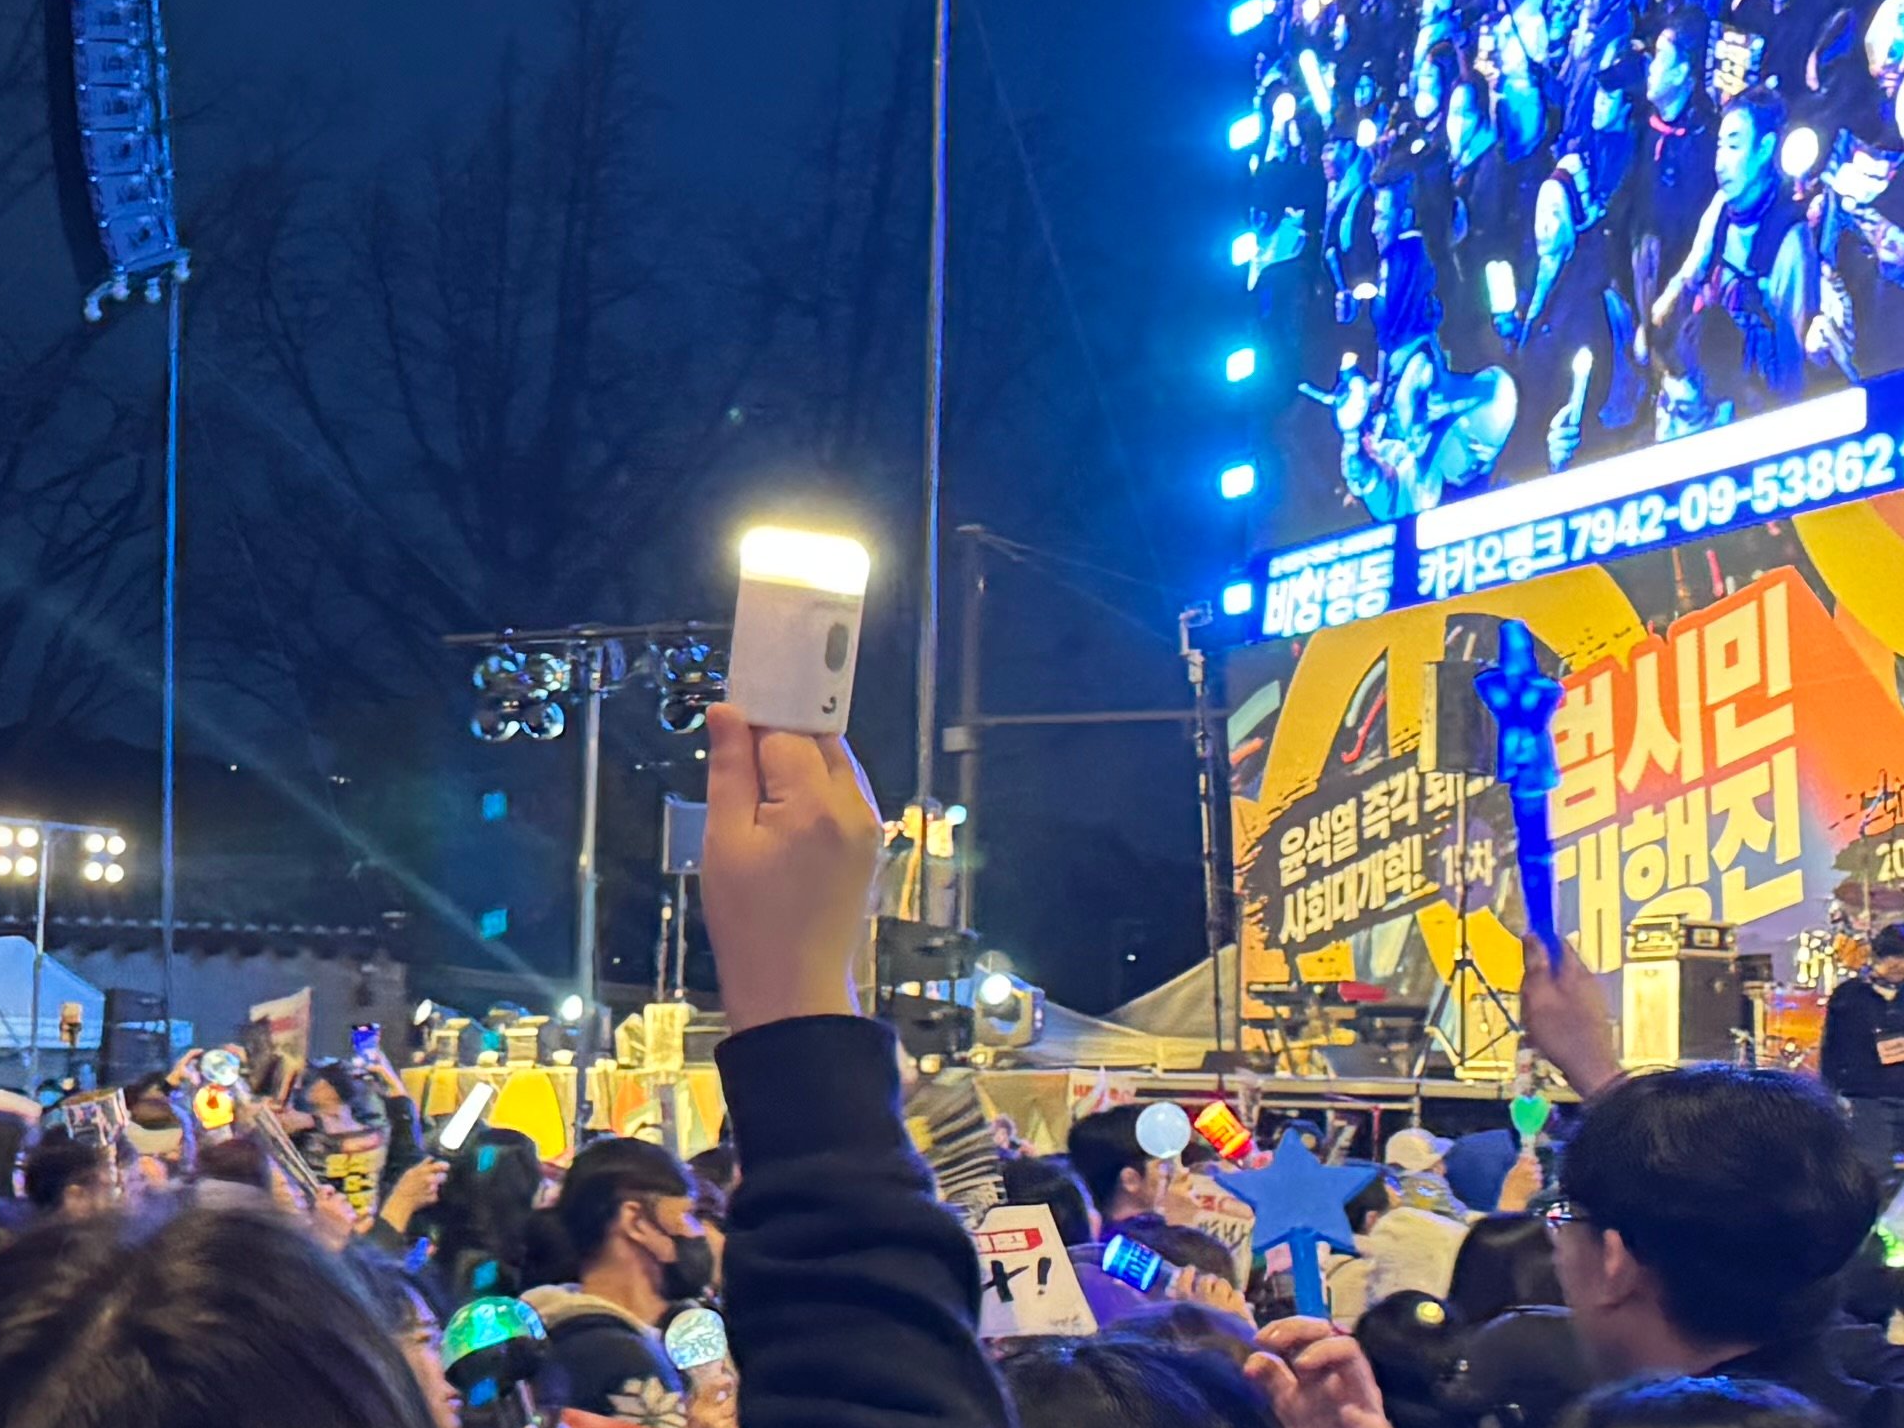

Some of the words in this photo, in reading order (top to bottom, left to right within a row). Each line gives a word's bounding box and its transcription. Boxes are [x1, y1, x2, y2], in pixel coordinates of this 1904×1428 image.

[1262, 549, 1394, 638] 비상행동
[1417, 518, 1567, 600] 카카오뱅크
[1569, 433, 1895, 561] 7942-09-53862
[1549, 581, 1796, 839] 범시민
[1279, 798, 1358, 887] 윤석열
[1362, 766, 1420, 839] 즉각
[1279, 834, 1427, 944] 사회대개혁!
[1441, 838, 1497, 888] 1차
[1553, 747, 1804, 974] 대행진
